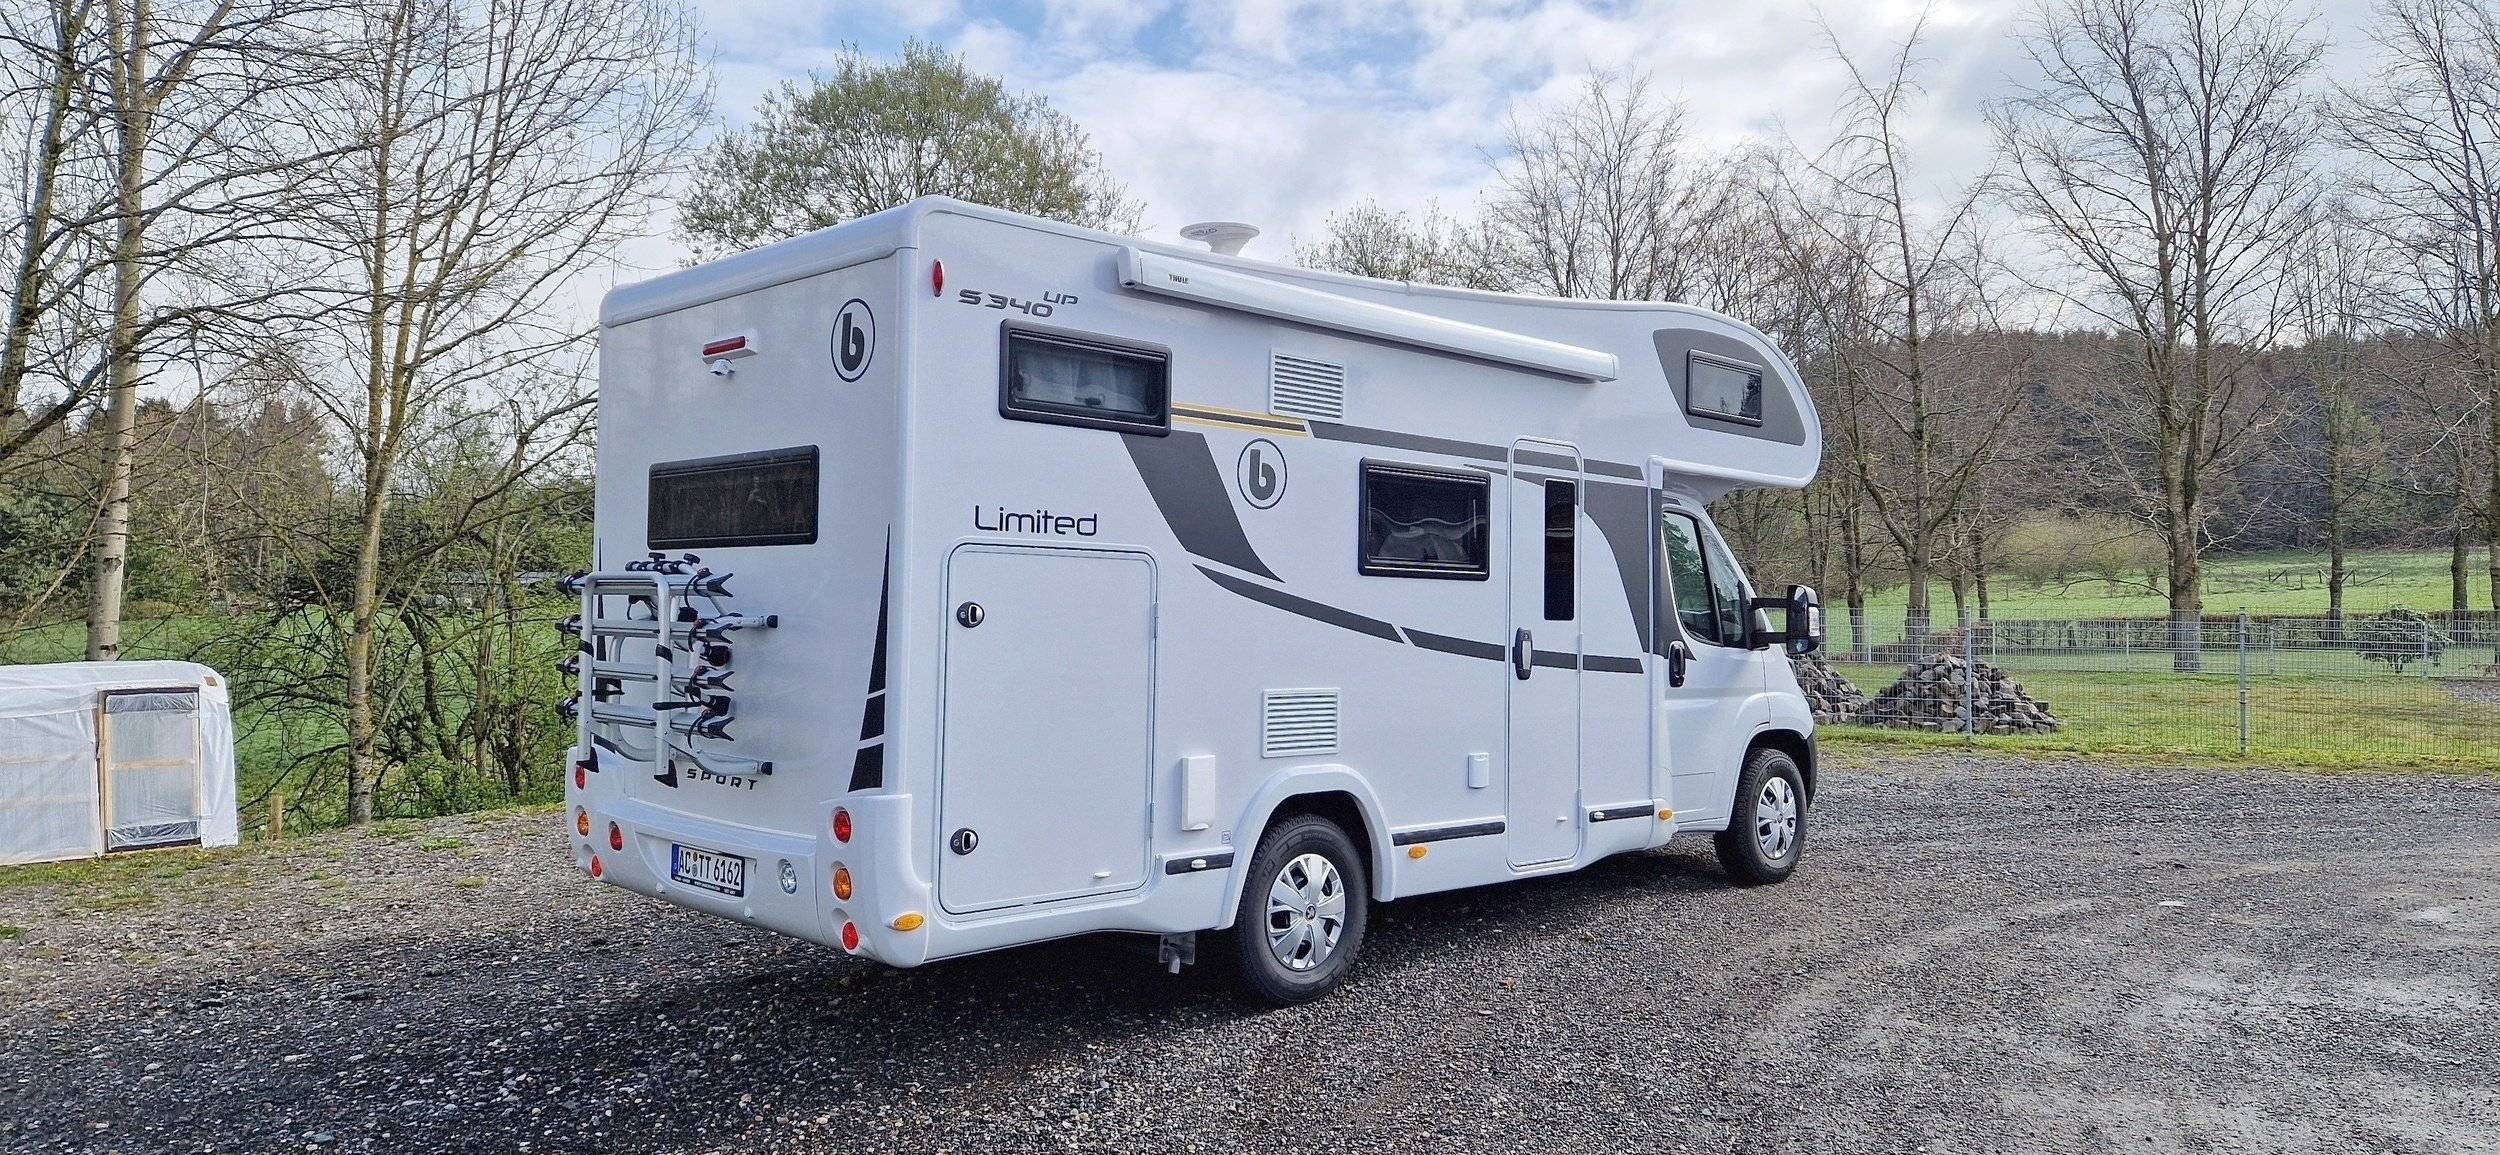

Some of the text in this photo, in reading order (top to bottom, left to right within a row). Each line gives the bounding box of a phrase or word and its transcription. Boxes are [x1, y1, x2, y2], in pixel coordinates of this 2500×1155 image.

[1168, 273, 1189, 285] THULE
[958, 289, 1053, 318] S 340
[1043, 290, 1079, 305] UP
[975, 505, 1097, 537] Limited
[687, 768, 758, 790] SPORT
[679, 850, 691, 875] AC
[699, 854, 712, 879] TT
[714, 858, 741, 887] 6162
